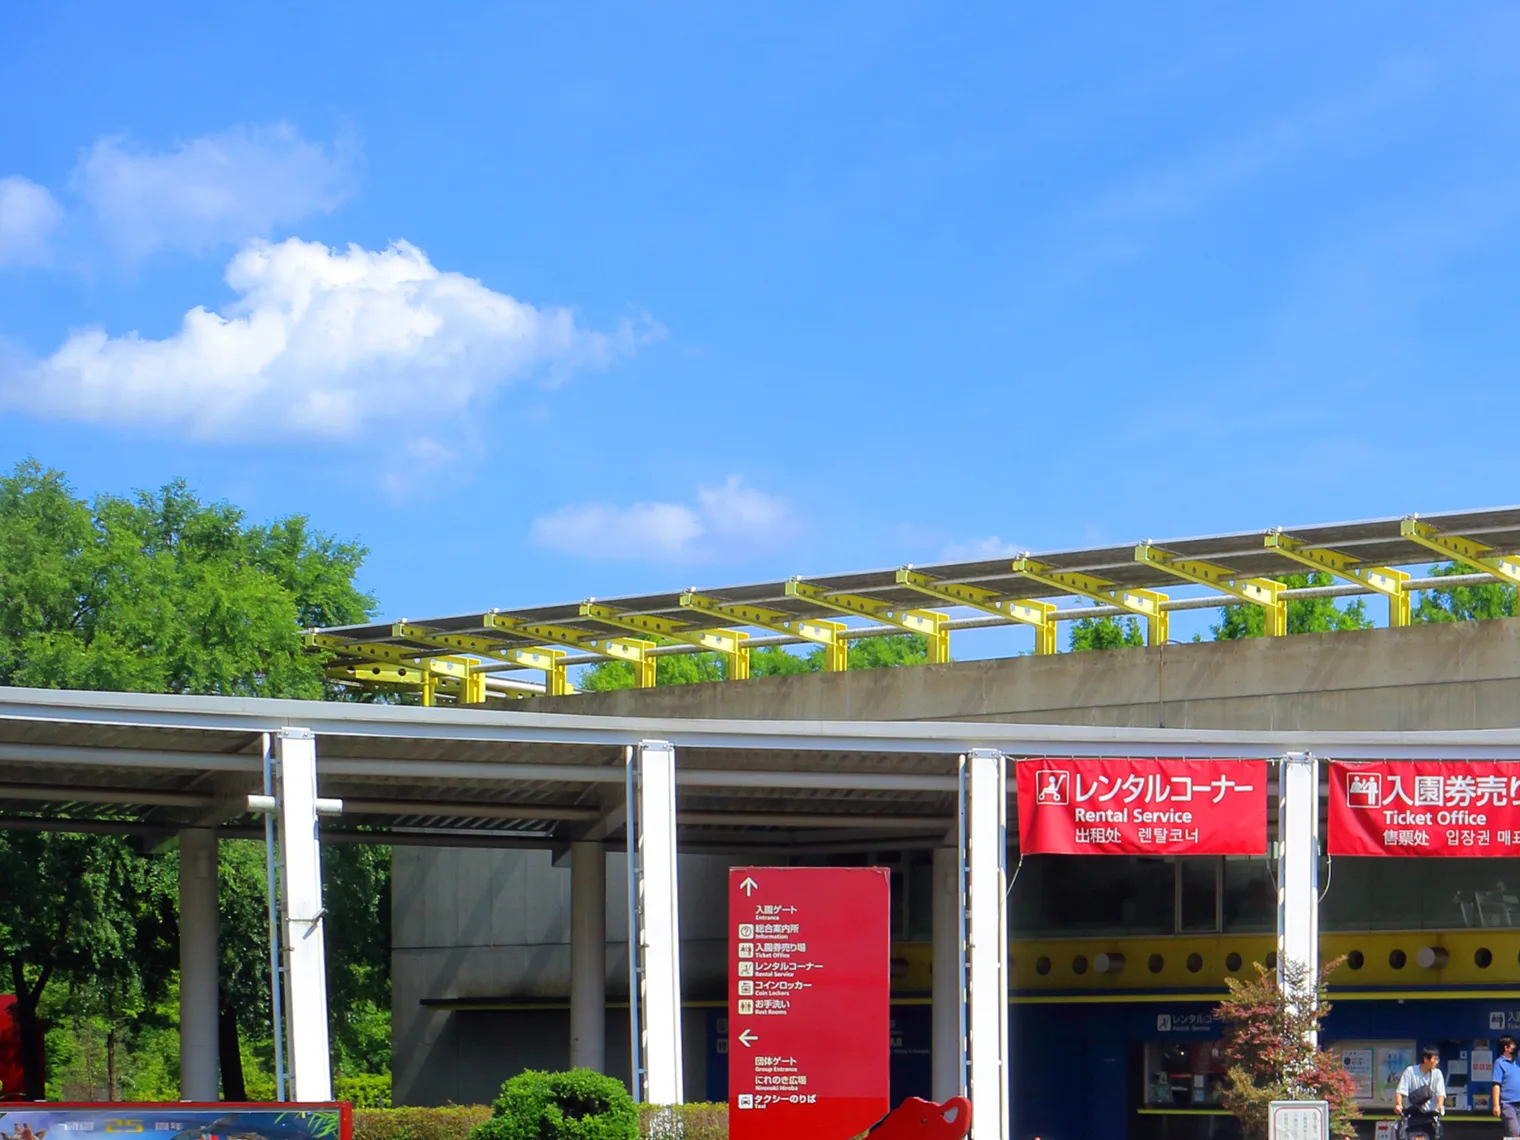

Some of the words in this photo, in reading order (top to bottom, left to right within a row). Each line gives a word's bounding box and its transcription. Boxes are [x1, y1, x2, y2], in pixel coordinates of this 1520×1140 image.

[1075, 773, 1254, 804] レンタルコーナー
[1075, 808, 1128, 823] Rental
[1133, 808, 1193, 823] Service
[1383, 810, 1433, 826] Ticket
[1437, 810, 1488, 826] Office
[1075, 828, 1122, 844] 出租处
[1138, 827, 1199, 844] 렌탈코너
[1383, 829, 1430, 847] 售票处
[1446, 829, 1491, 847] 입장권
[755, 905, 798, 915] 入園ゲート
[755, 924, 799, 933] 総合案内所
[755, 943, 806, 952] 入園券売り場
[755, 961, 824, 971] レンタルコーナー
[755, 980, 812, 990] コインロッカー
[1173, 1014, 1226, 1024] レンタルコー
[754, 1057, 797, 1066] 団体ゲート
[754, 1094, 817, 1104] タクシーのりば
